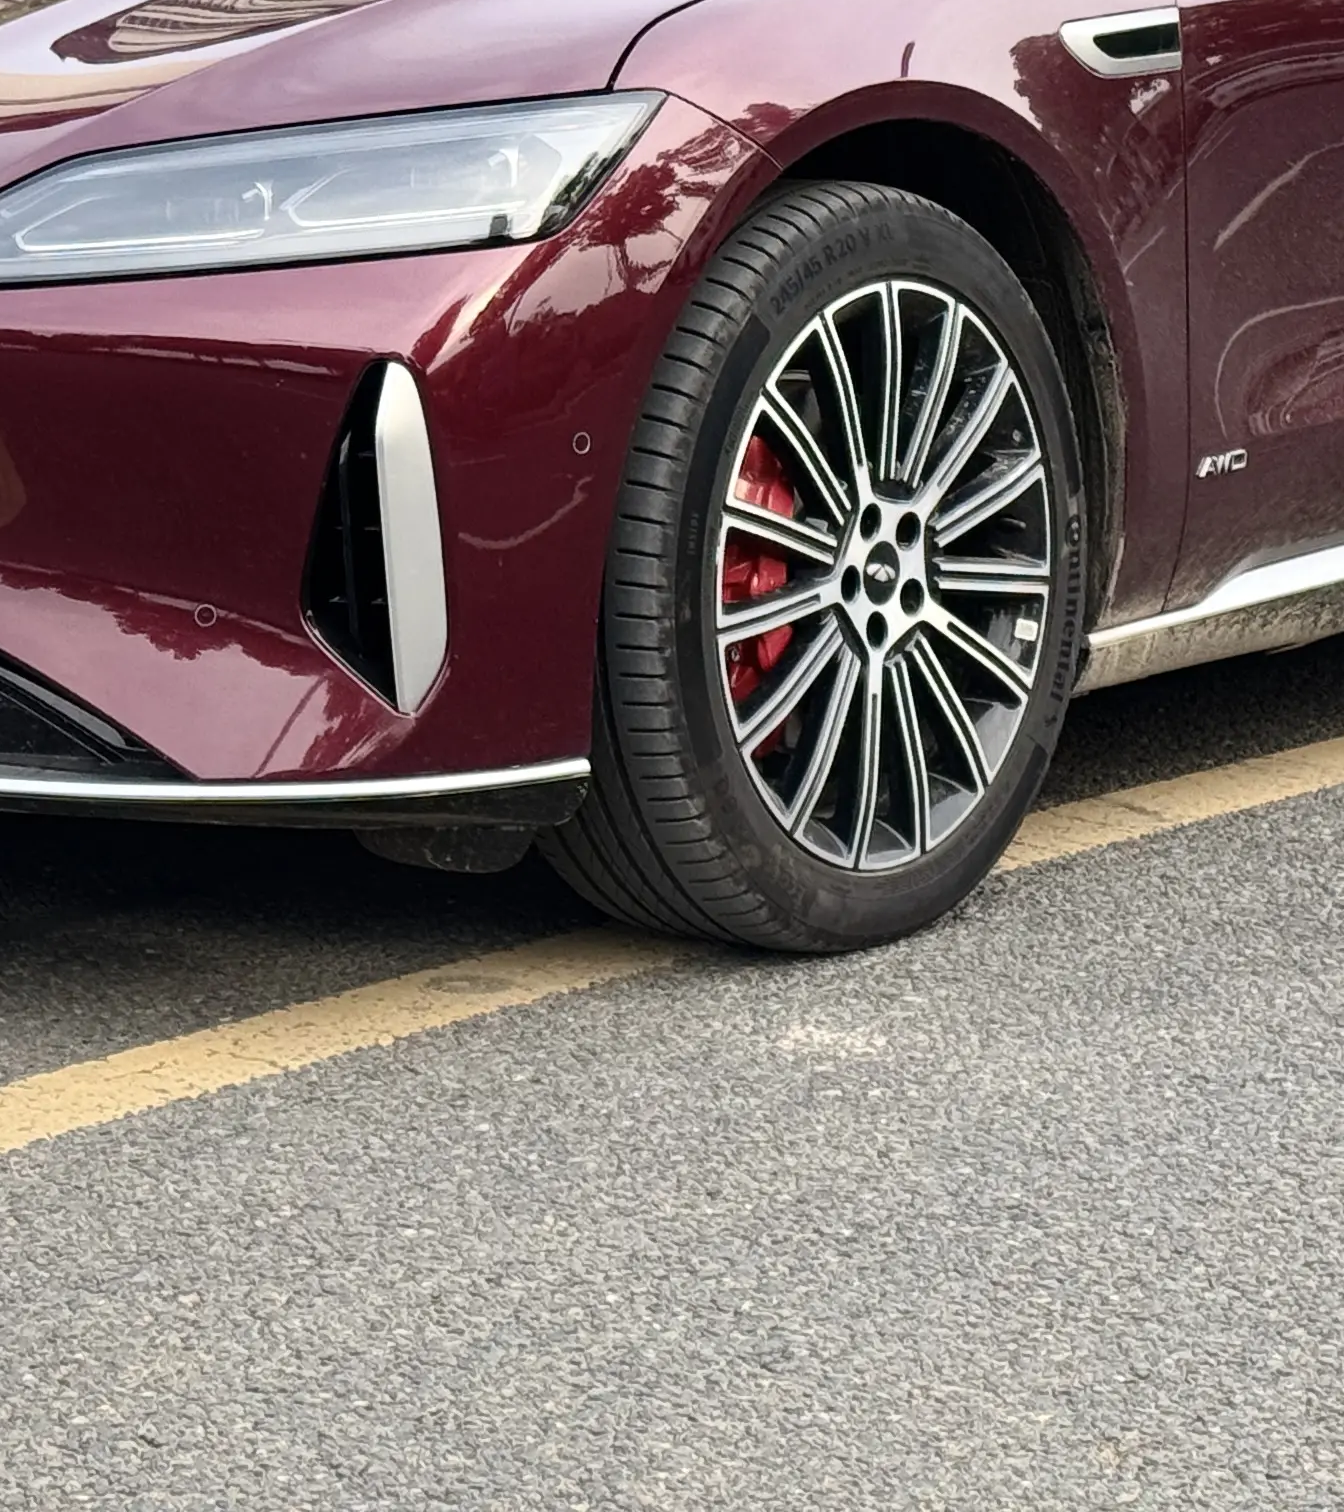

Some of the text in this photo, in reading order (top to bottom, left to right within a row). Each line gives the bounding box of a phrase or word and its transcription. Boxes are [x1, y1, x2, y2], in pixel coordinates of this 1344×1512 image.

[769, 255, 824, 316] 245/45
[822, 233, 857, 267] R20
[1196, 448, 1248, 478] AWD
